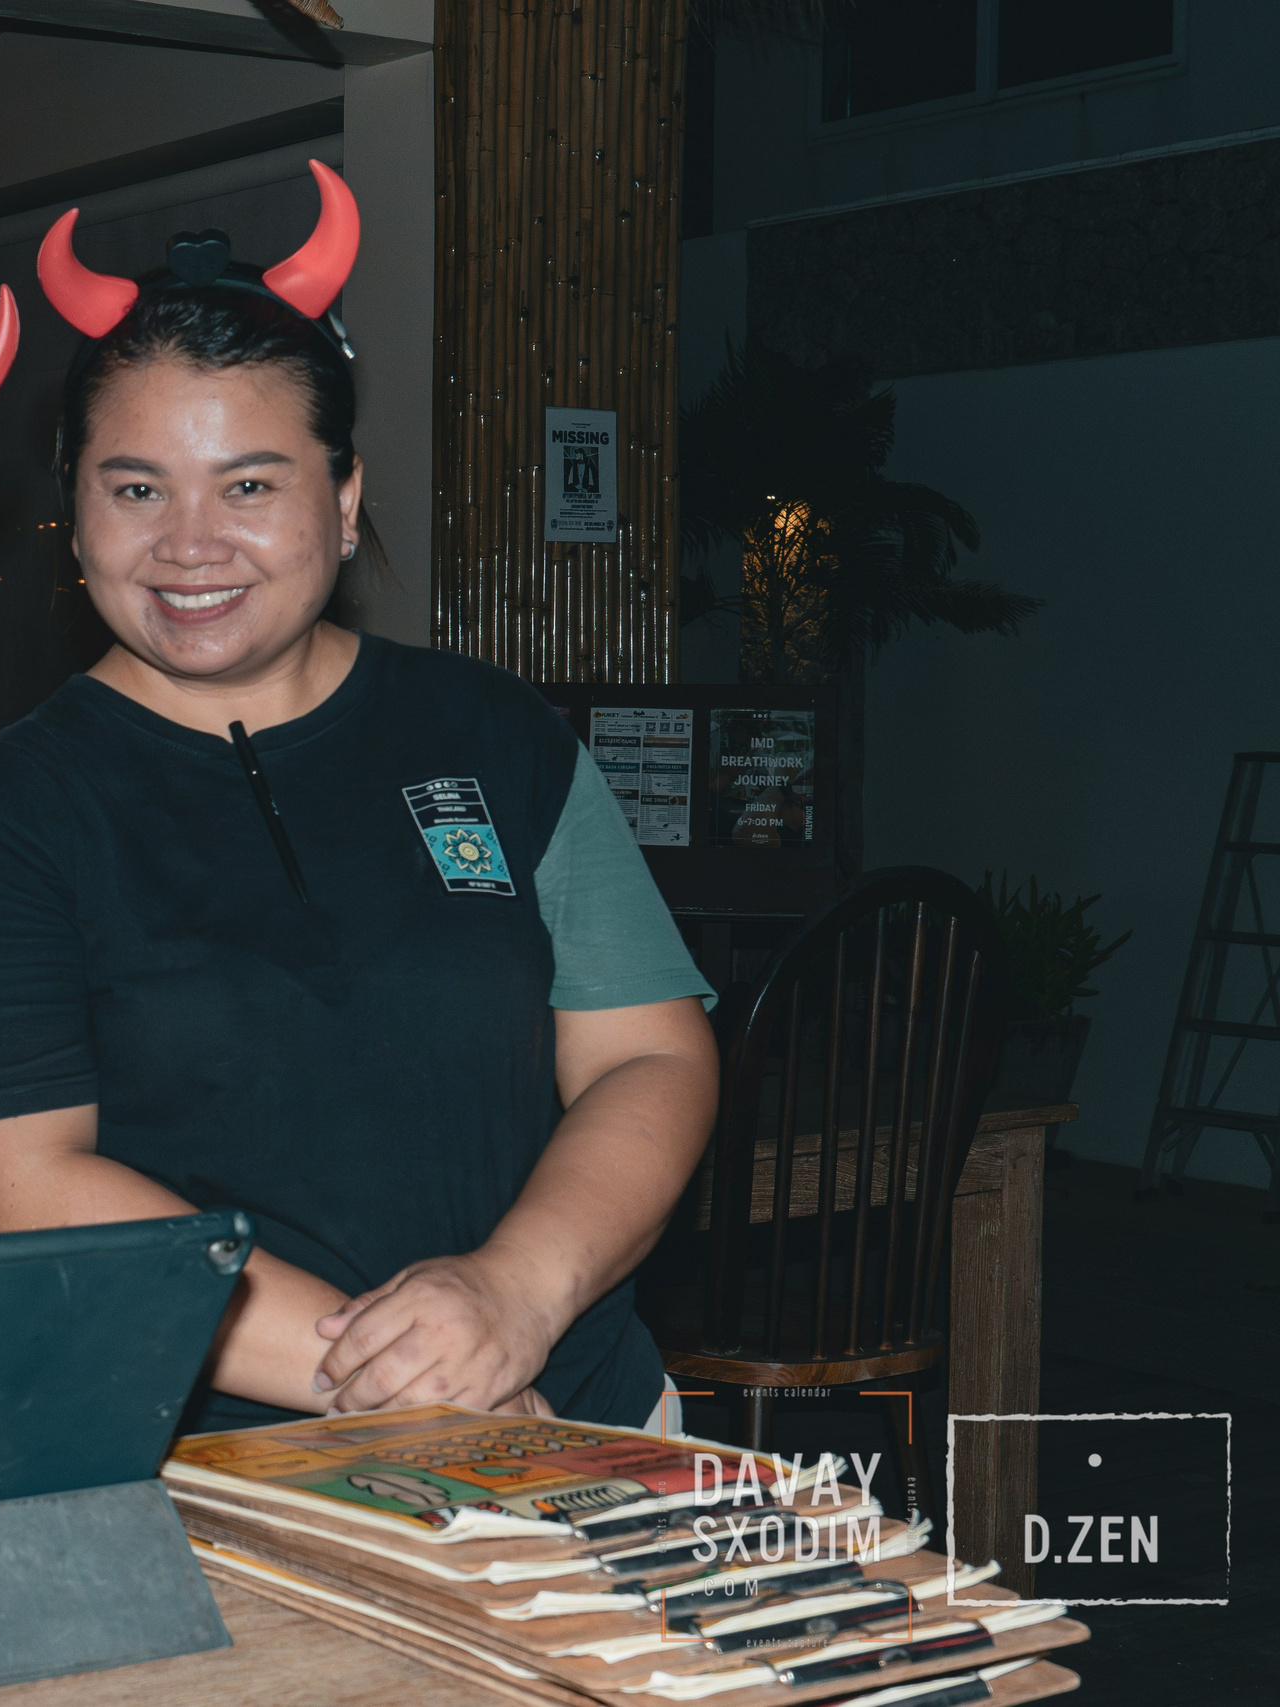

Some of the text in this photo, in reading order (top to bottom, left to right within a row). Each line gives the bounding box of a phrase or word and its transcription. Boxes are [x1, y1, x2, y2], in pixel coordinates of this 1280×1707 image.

[552, 429, 610, 445] MISSING
[750, 737, 775, 749] IMD
[721, 755, 804, 768] BREATHWORK
[733, 774, 790, 787] JOURNEY
[769, 818, 784, 827] PM
[805, 805, 813, 840] DONATION
